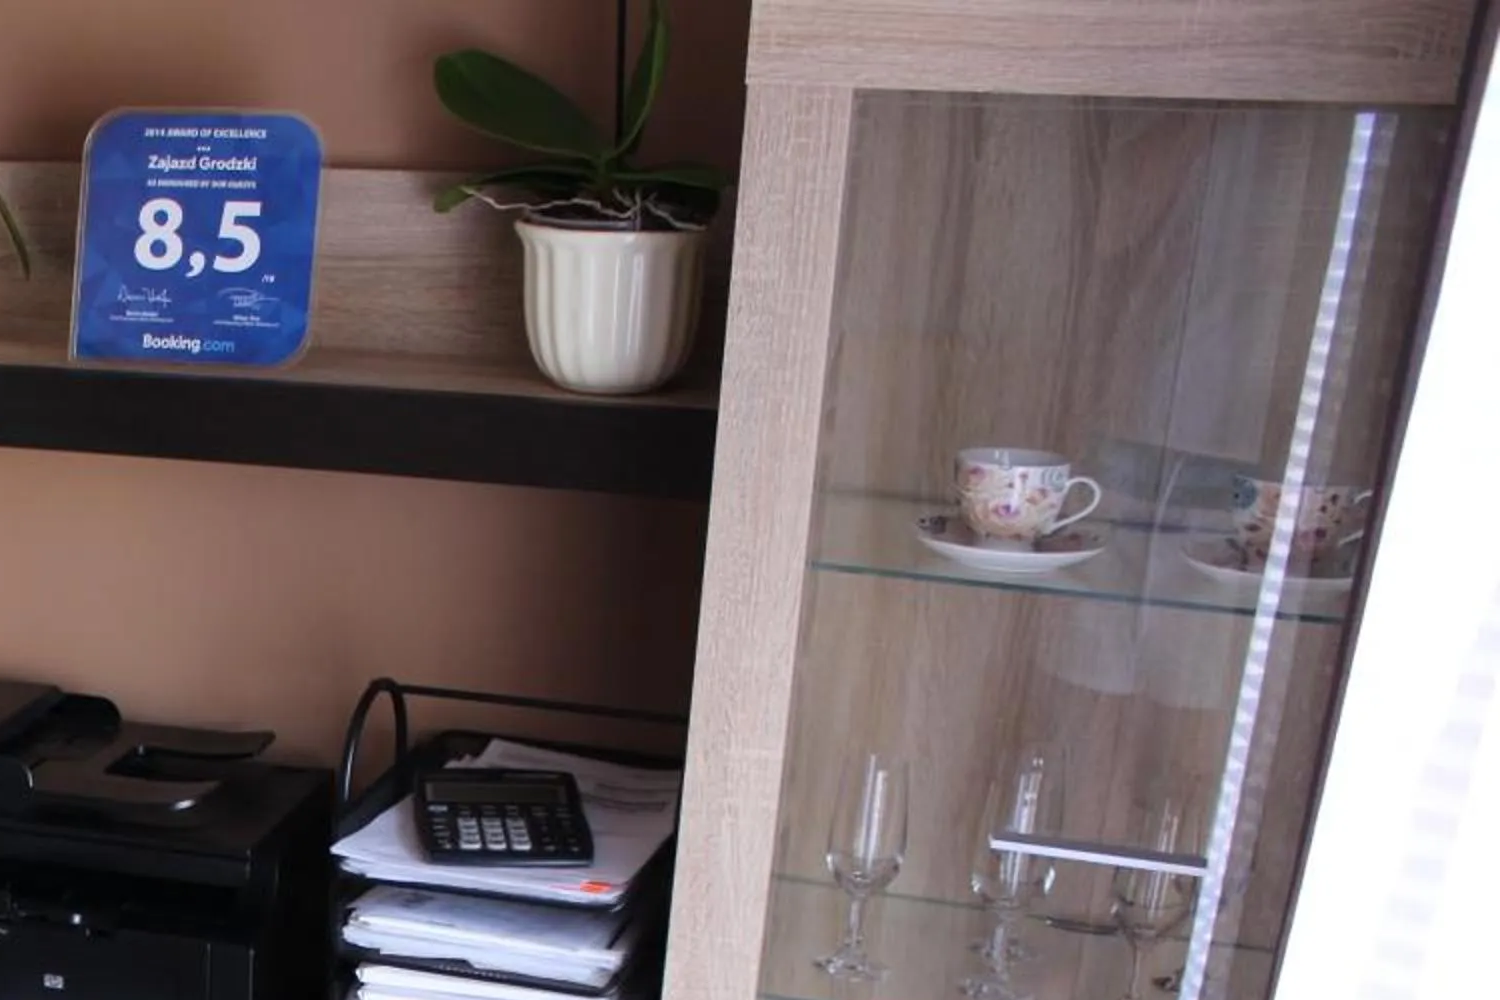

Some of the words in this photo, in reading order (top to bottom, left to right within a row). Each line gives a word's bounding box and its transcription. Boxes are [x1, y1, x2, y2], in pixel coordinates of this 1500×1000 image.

[147, 155, 197, 173] Zajazd
[199, 156, 257, 171] Grodzki
[134, 198, 263, 278] 8,5
[142, 333, 235, 354] Booking.com
